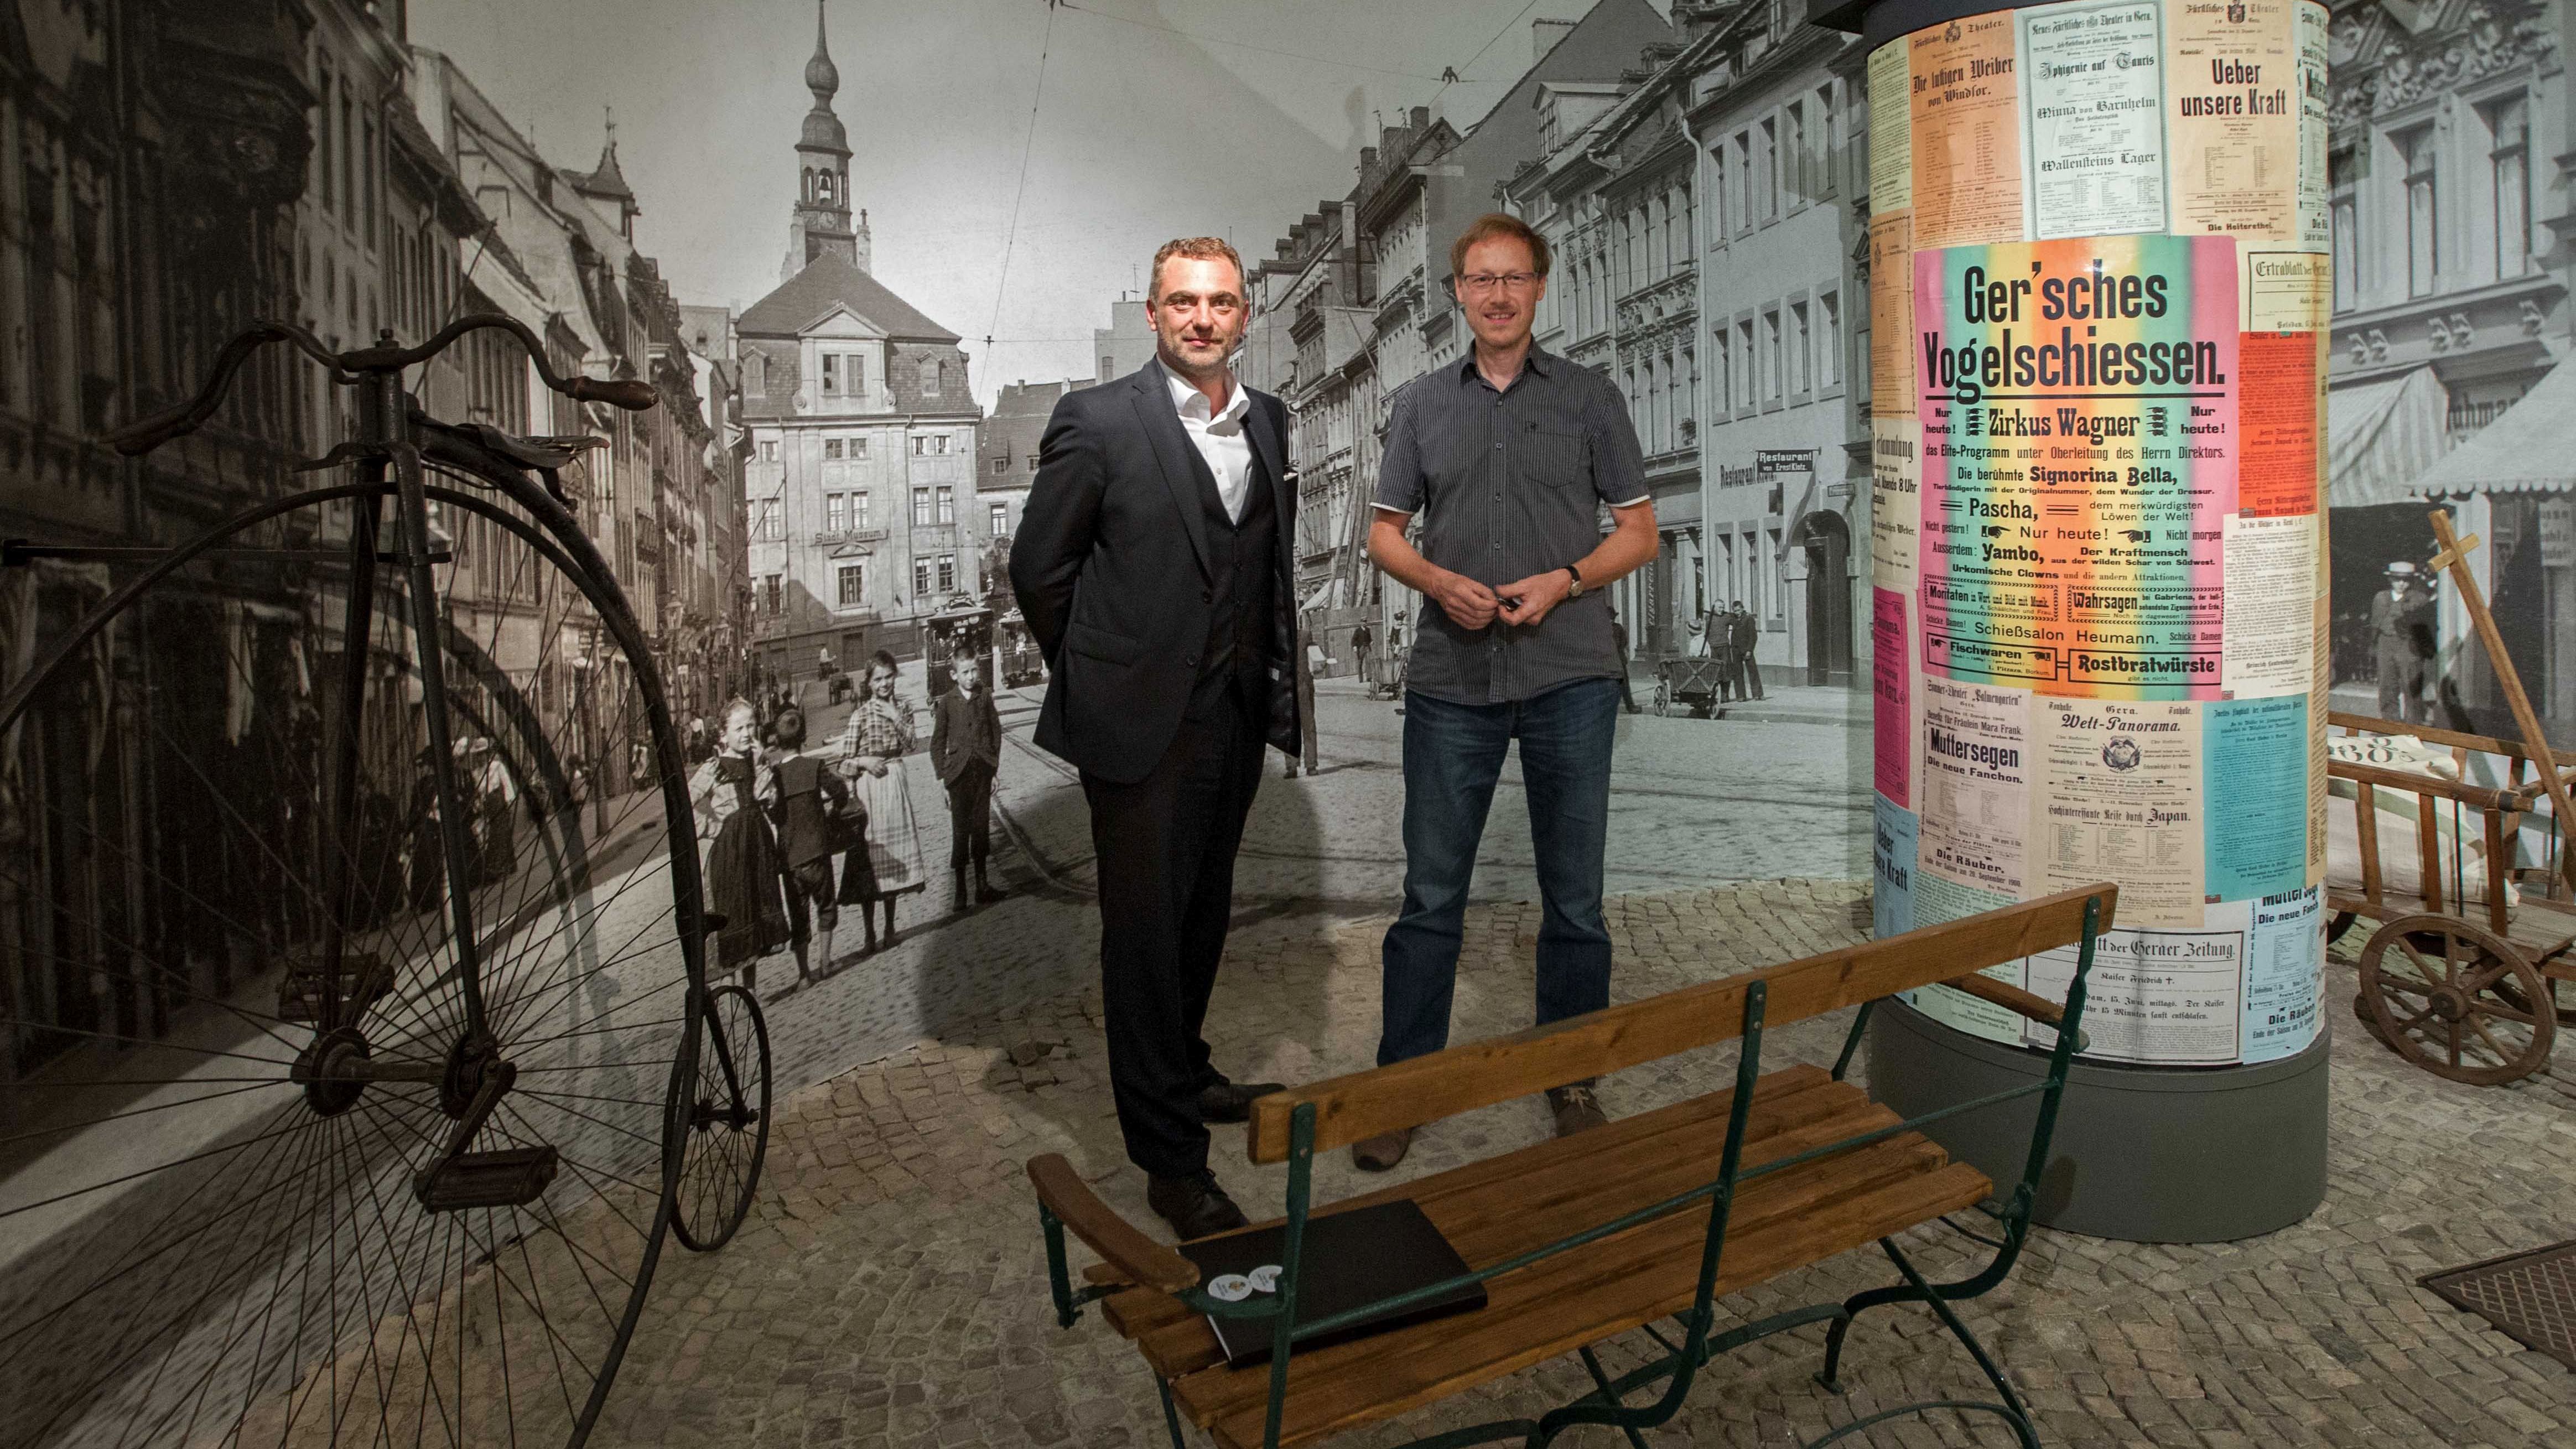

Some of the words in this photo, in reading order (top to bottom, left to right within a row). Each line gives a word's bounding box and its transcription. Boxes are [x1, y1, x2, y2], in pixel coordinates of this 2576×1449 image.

[2092, 59, 2106, 71] auf
[2212, 58, 2261, 84] Ueber
[1913, 76, 1927, 97] Die
[1970, 58, 2014, 81] Weiber
[1928, 97, 1941, 107] von
[2037, 106, 2076, 120] Minna
[2096, 97, 2156, 111] Barnhelm
[2181, 95, 2242, 116] unsere
[2249, 89, 2287, 115] Kraft
[2121, 153, 2156, 165] Lager
[1924, 325, 2225, 405] Vogelschiessen.
[1935, 408, 1952, 418] Nur
[2191, 406, 2215, 417] Nur
[1926, 424, 1956, 434] heute!
[1989, 408, 2052, 437] Zirkus
[2056, 408, 2140, 445] Wagner
[2181, 423, 2225, 434] heute!
[1759, 451, 1812, 463] Restaurant
[1926, 444, 1938, 456] das
[1941, 444, 2009, 460] Elite-Programm
[2017, 446, 2043, 459] unter
[2051, 446, 2108, 461] Oberleitung
[2116, 446, 2134, 459] des
[2142, 447, 2170, 459] Herrn
[2178, 446, 2225, 459] Direktors.
[1721, 461, 1756, 489] Restaurant
[1957, 466, 1972, 480] Die
[1977, 467, 2024, 481] berühmte
[2029, 466, 2118, 486] Signorina
[2127, 466, 2178, 486] Bella,
[1899, 478, 1904, 492] 8
[1905, 479, 1917, 494] Uhr
[1933, 483, 1981, 494] Tierbändigerin
[1985, 485, 1997, 494] mit
[2019, 487, 2092, 496] Originalnummer,
[1969, 497, 2038, 521] Pascha,
[2090, 501, 2113, 510] dem
[2120, 501, 2204, 511] merkwürdigsten
[2101, 512, 2137, 521] Löwen
[2143, 512, 2160, 521] der
[2165, 512, 2194, 521] Welt!
[1925, 521, 1939, 531] Nicht
[2020, 526, 2049, 538] Nur
[2058, 527, 2108, 540] heute!
[2166, 529, 2188, 541] Nicht
[1932, 541, 1977, 557] Ausserdem:
[1982, 542, 2045, 564] Yambo,
[2080, 547, 2102, 555] Der
[2110, 547, 2188, 557] Kraftmensch
[1952, 564, 2013, 577] Urkomische
[2018, 569, 2059, 579] Clowns
[1929, 585, 1969, 602] Moritaten
[2074, 592, 2137, 612] Wahrsagen
[1975, 622, 2064, 640] Schießsalon
[2076, 630, 2159, 645] Heumann.
[2169, 632, 2196, 641] Schicke
[1950, 642, 2022, 659] Fischwaren
[2078, 655, 2215, 673] Rostbratwürste
[2106, 705, 2138, 714] Gera.
[1954, 716, 1978, 729] Fräulein
[1981, 722, 1998, 733] Mara
[2001, 725, 2023, 735] Frank.
[2061, 714, 2180, 732] Welt-Panorama.
[1930, 728, 2018, 770] Muttersegen
[1928, 756, 1940, 767] Die
[1943, 762, 1965, 774] neue
[1970, 767, 2023, 784] Fanchon.
[2147, 808, 2191, 825] Japan.
[1937, 849, 1951, 861] Die
[1956, 856, 2004, 874] Räuber.
[1887, 858, 1908, 892] Kraft
[2259, 914, 2274, 924] Die
[2279, 910, 2300, 921] neue
[2110, 942, 2128, 953] der
[2131, 941, 2180, 956] Geraer
[2101, 973, 2125, 981] Kaiser
[2130, 975, 2162, 984] Friedrich
[2114, 1007, 2146, 1019] Minuten
[2151, 1011, 2167, 1019] sanft
[2269, 1015, 2286, 1025] Die
